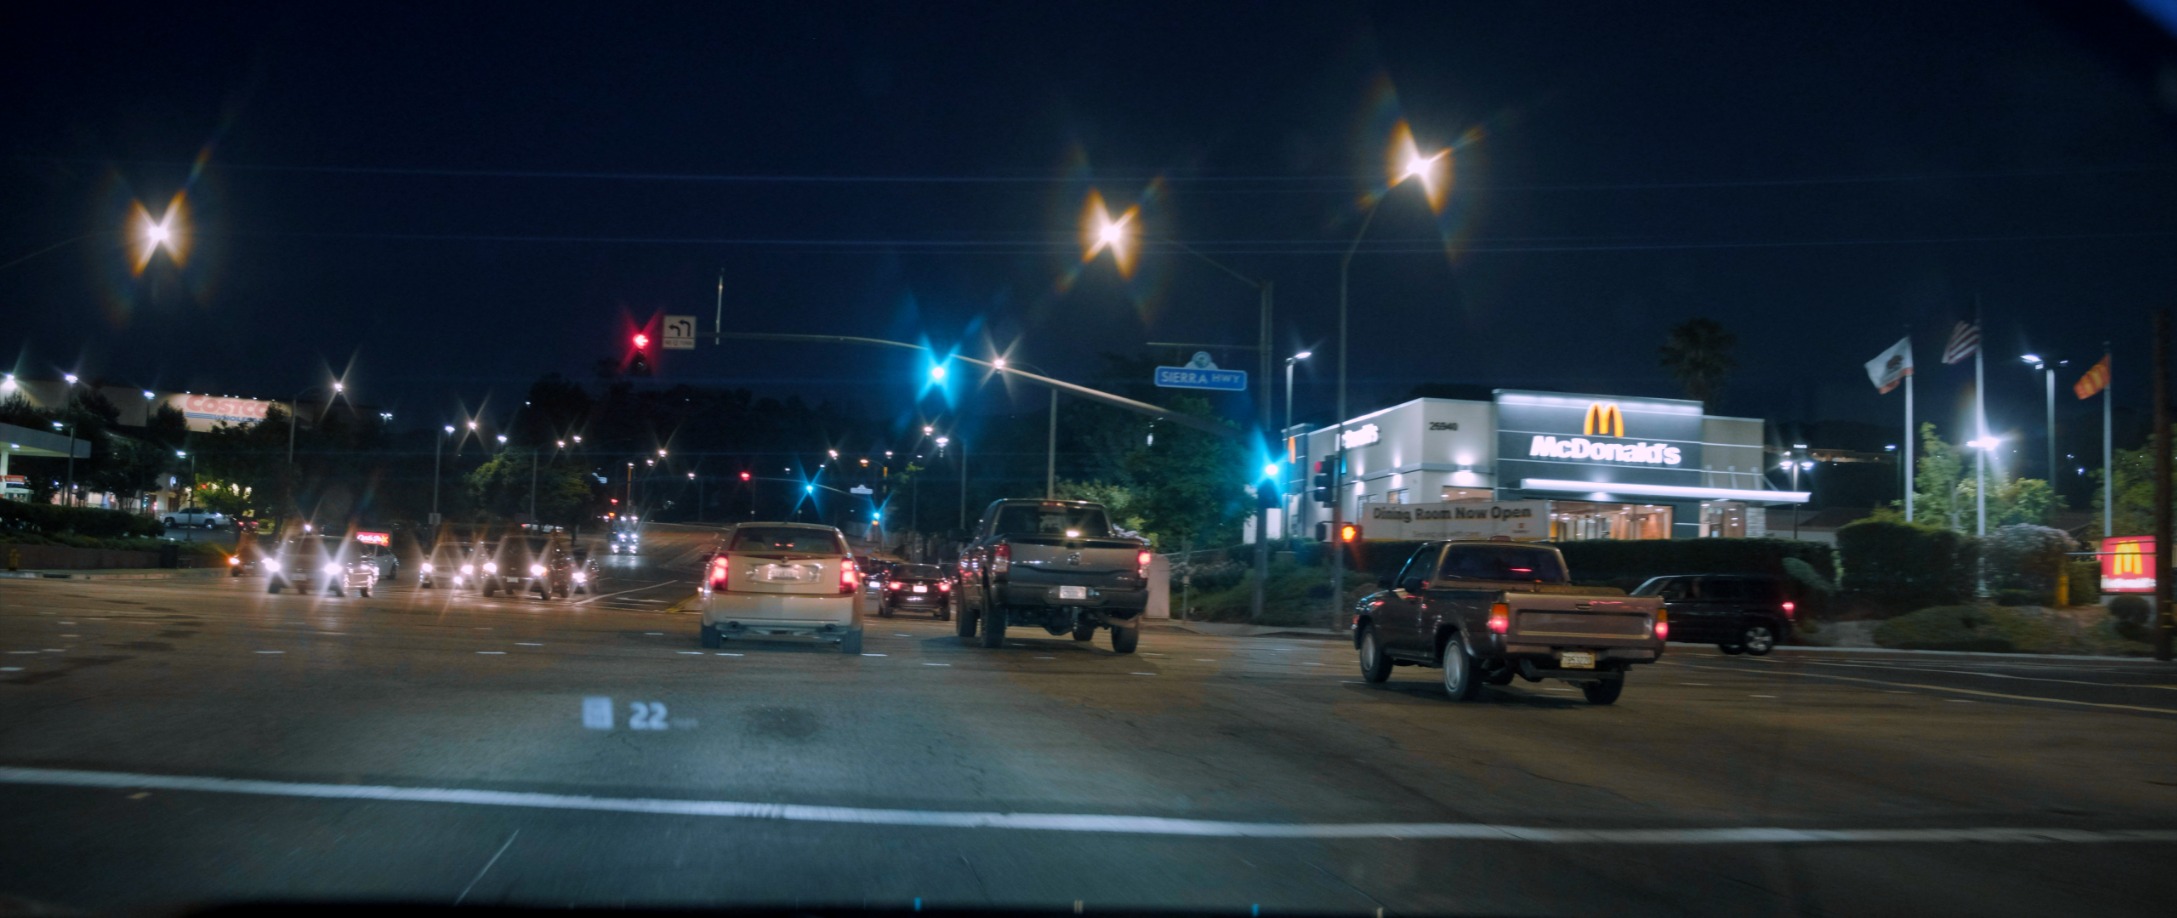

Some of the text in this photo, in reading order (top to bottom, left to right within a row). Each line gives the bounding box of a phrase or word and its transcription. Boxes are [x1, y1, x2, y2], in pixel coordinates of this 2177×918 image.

[1161, 370, 1241, 384] SIERRA HWY
[1529, 435, 1682, 466] McDonald's
[1373, 506, 1532, 523] Dining Room Now Open
[628, 701, 669, 731] 22
